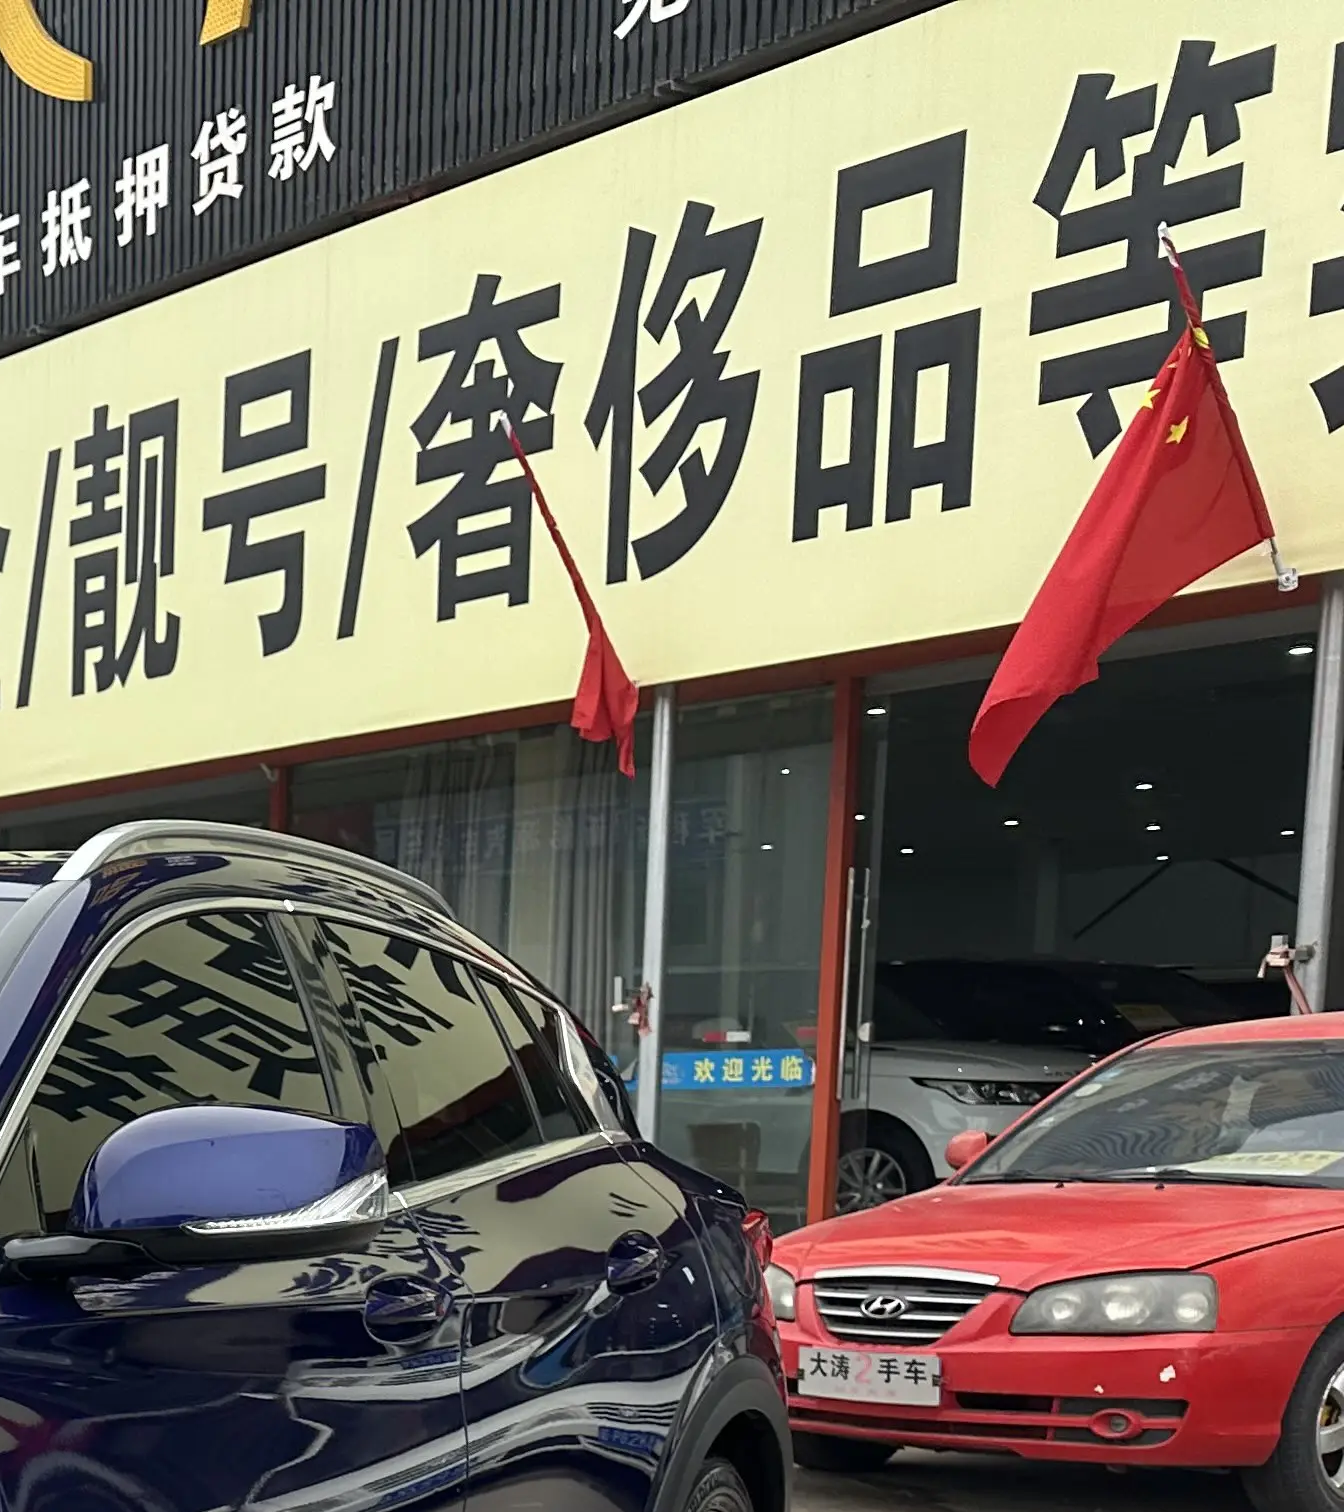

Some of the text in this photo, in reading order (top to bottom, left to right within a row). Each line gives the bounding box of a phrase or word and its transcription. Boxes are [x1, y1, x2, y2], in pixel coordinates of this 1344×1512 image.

[693, 1056, 805, 1083] 欢迎光临
[810, 1352, 928, 1385] 大涛2手车
